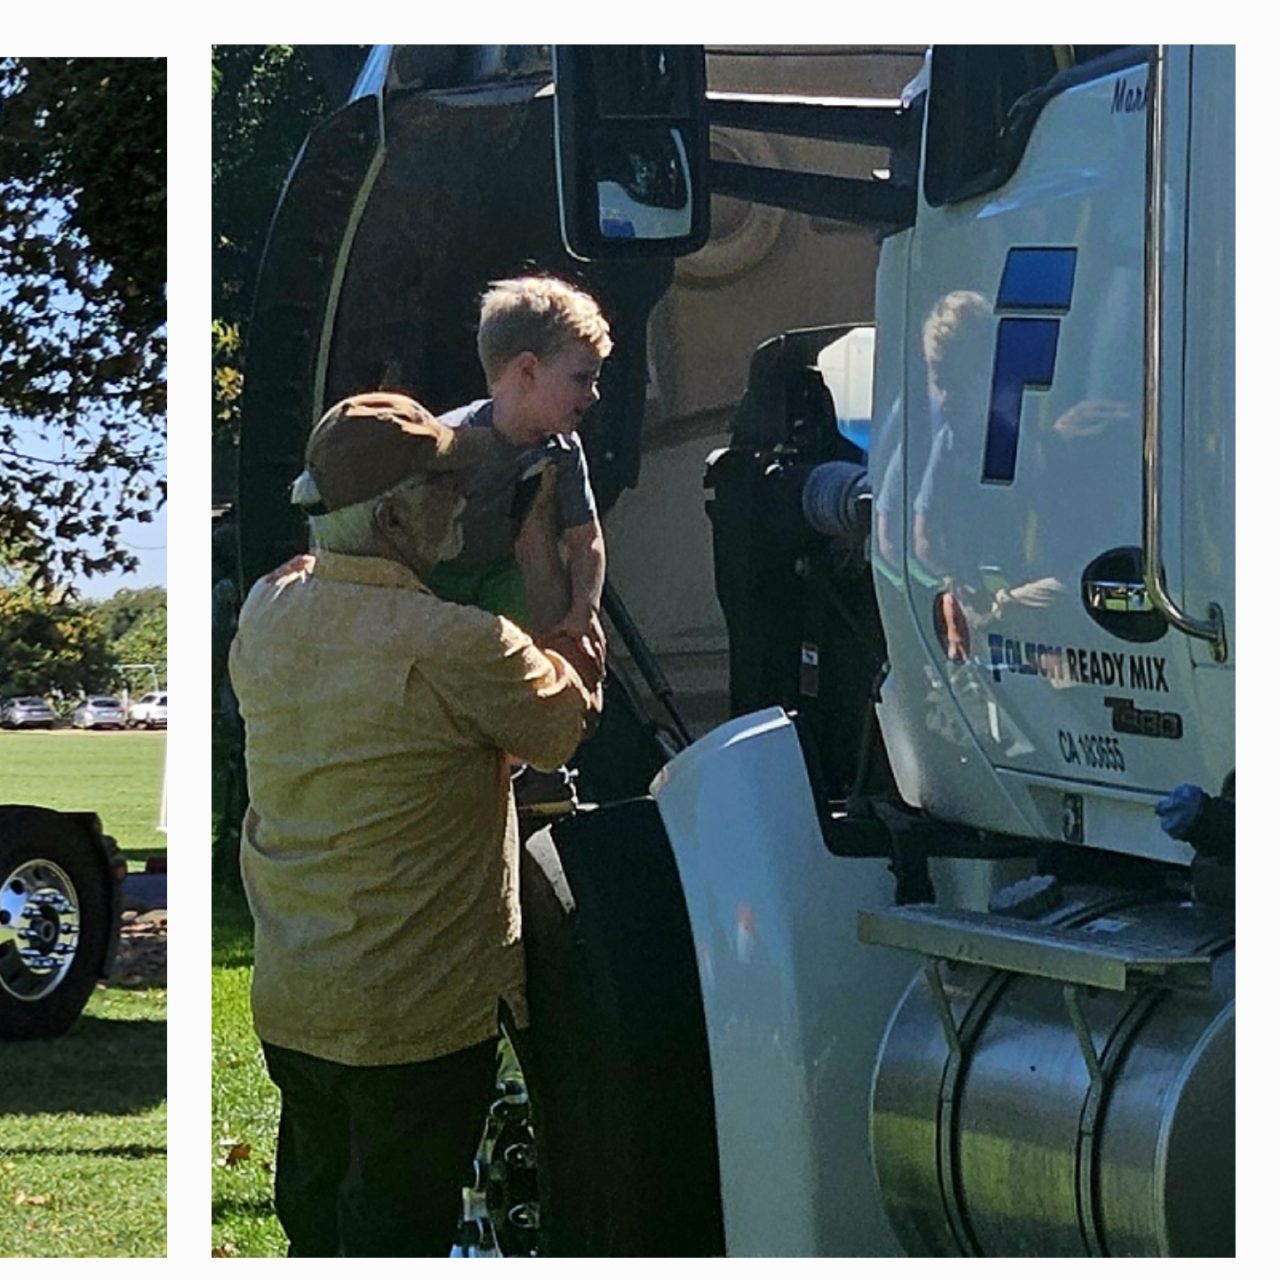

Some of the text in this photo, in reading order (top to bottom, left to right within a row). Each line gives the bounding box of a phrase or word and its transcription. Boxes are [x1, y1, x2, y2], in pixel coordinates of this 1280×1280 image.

[1066, 648, 1124, 688] READY
[1129, 655, 1169, 692] MIX
[1058, 730, 1081, 765] CA
